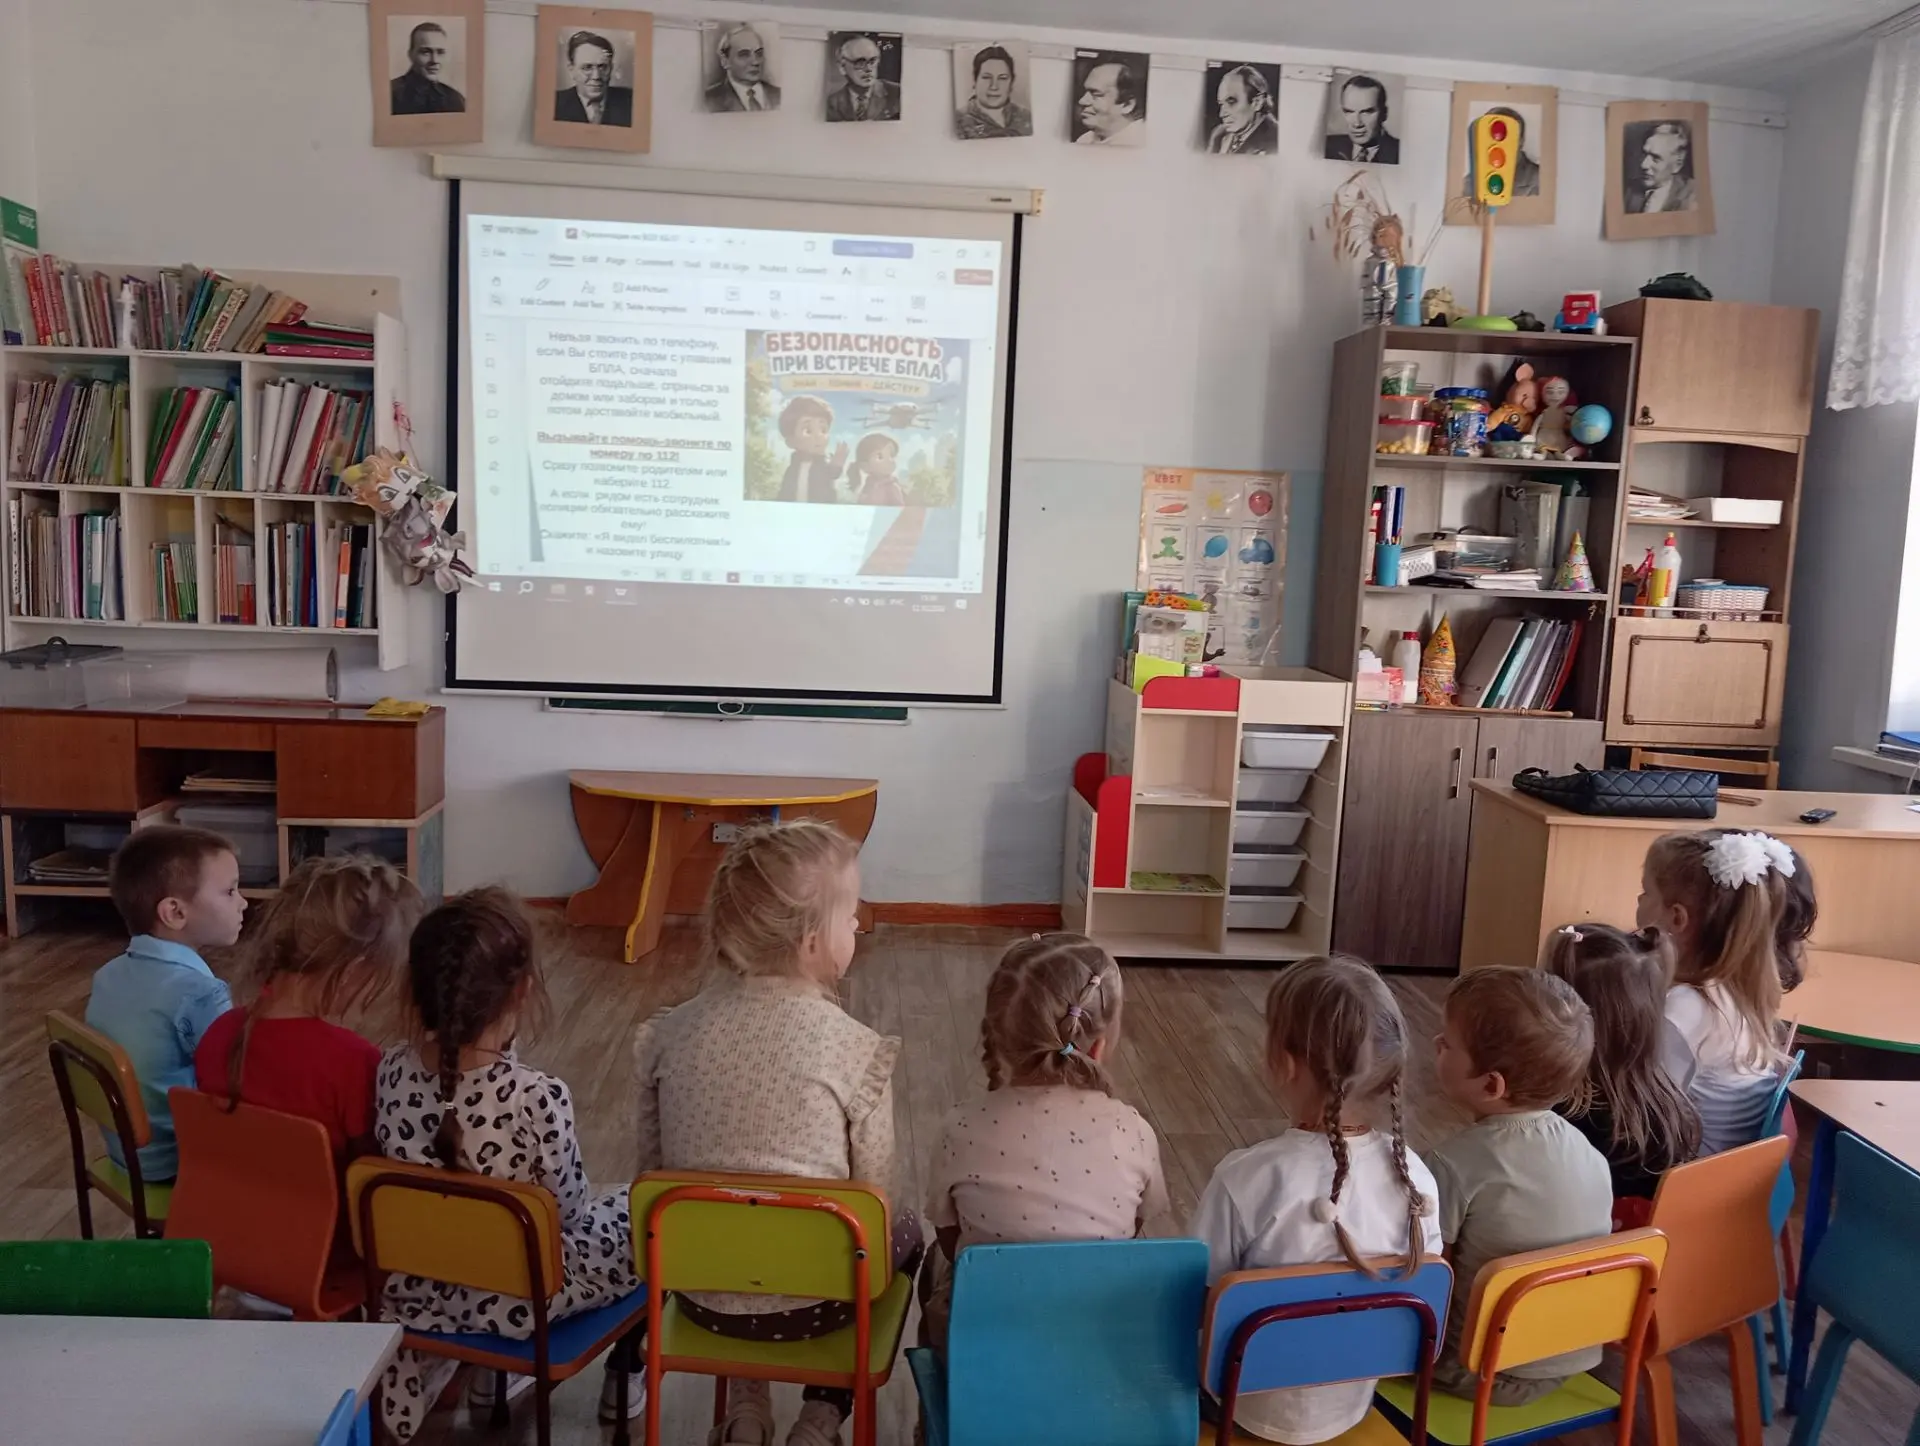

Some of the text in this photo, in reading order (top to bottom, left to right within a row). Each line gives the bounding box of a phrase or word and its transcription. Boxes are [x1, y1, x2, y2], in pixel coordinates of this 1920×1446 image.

[549, 331, 591, 342] Нельзя
[595, 334, 640, 344] звонить
[643, 337, 658, 345] по
[766, 332, 942, 360] БЕЗОПАСНОСТЬ
[536, 347, 566, 357] если
[568, 347, 585, 358] Вы
[588, 350, 627, 360] стоите
[630, 351, 667, 363] рядом
[589, 363, 625, 375] БПЛА,
[772, 355, 942, 380] ПРИ ВСТРЕЧЕ БПЛА
[539, 376, 593, 387] отойдите
[716, 385, 730, 393] за
[550, 392, 589, 402] домом
[592, 393, 614, 402] или
[618, 393, 667, 406] забором
[680, 397, 719, 407] только
[547, 405, 582, 415] потом
[584, 406, 651, 418] доставайте
[537, 431, 609, 443] Вызывайте
[717, 440, 732, 450] по
[589, 449, 635, 461] номеру
[638, 452, 654, 461] по
[542, 461, 727, 477] Сразу позвоните родителям или
[593, 476, 648, 488] наберите
[550, 489, 559, 498] А
[595, 491, 631, 503] рядом
[634, 494, 660, 503] есть
[661, 495, 719, 507] сотрудник
[591, 504, 662, 516] обязательно
[665, 508, 730, 519] расскажите
[596, 548, 647, 557] назовите
